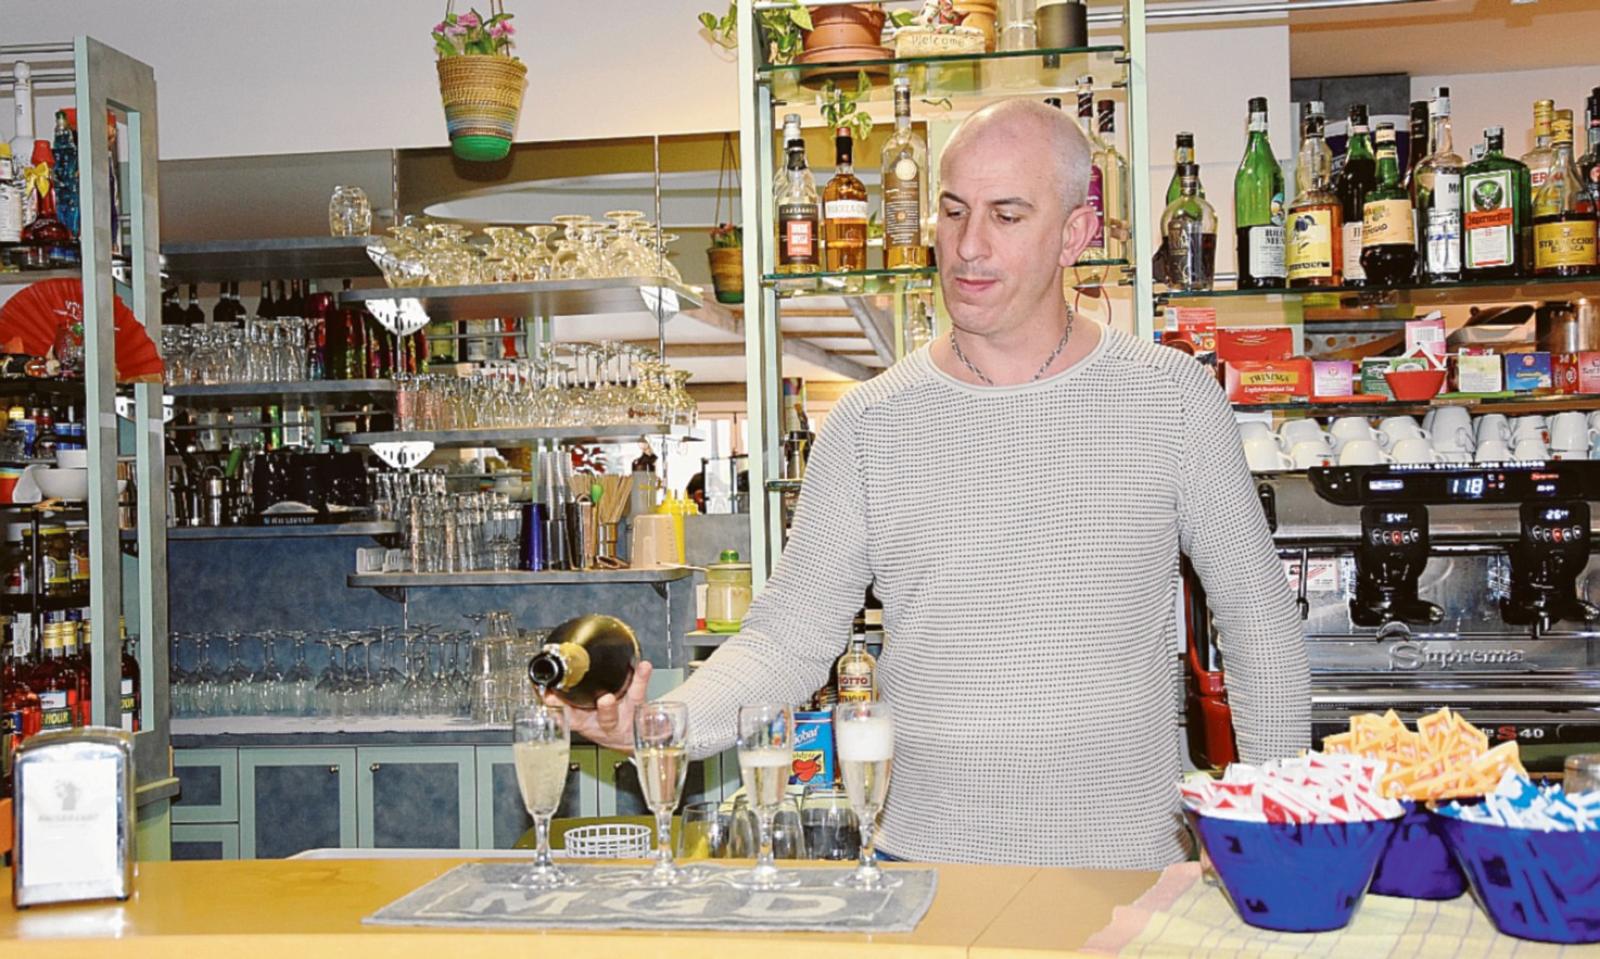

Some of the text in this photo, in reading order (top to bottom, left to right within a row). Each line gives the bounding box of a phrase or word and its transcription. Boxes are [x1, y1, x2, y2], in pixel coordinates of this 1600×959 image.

[911, 34, 966, 48] Welcome
[1467, 212, 1511, 227] Jägermeister
[1451, 478, 1484, 495] 118
[1388, 641, 1526, 671] Suprema
[465, 889, 848, 917] MGD
